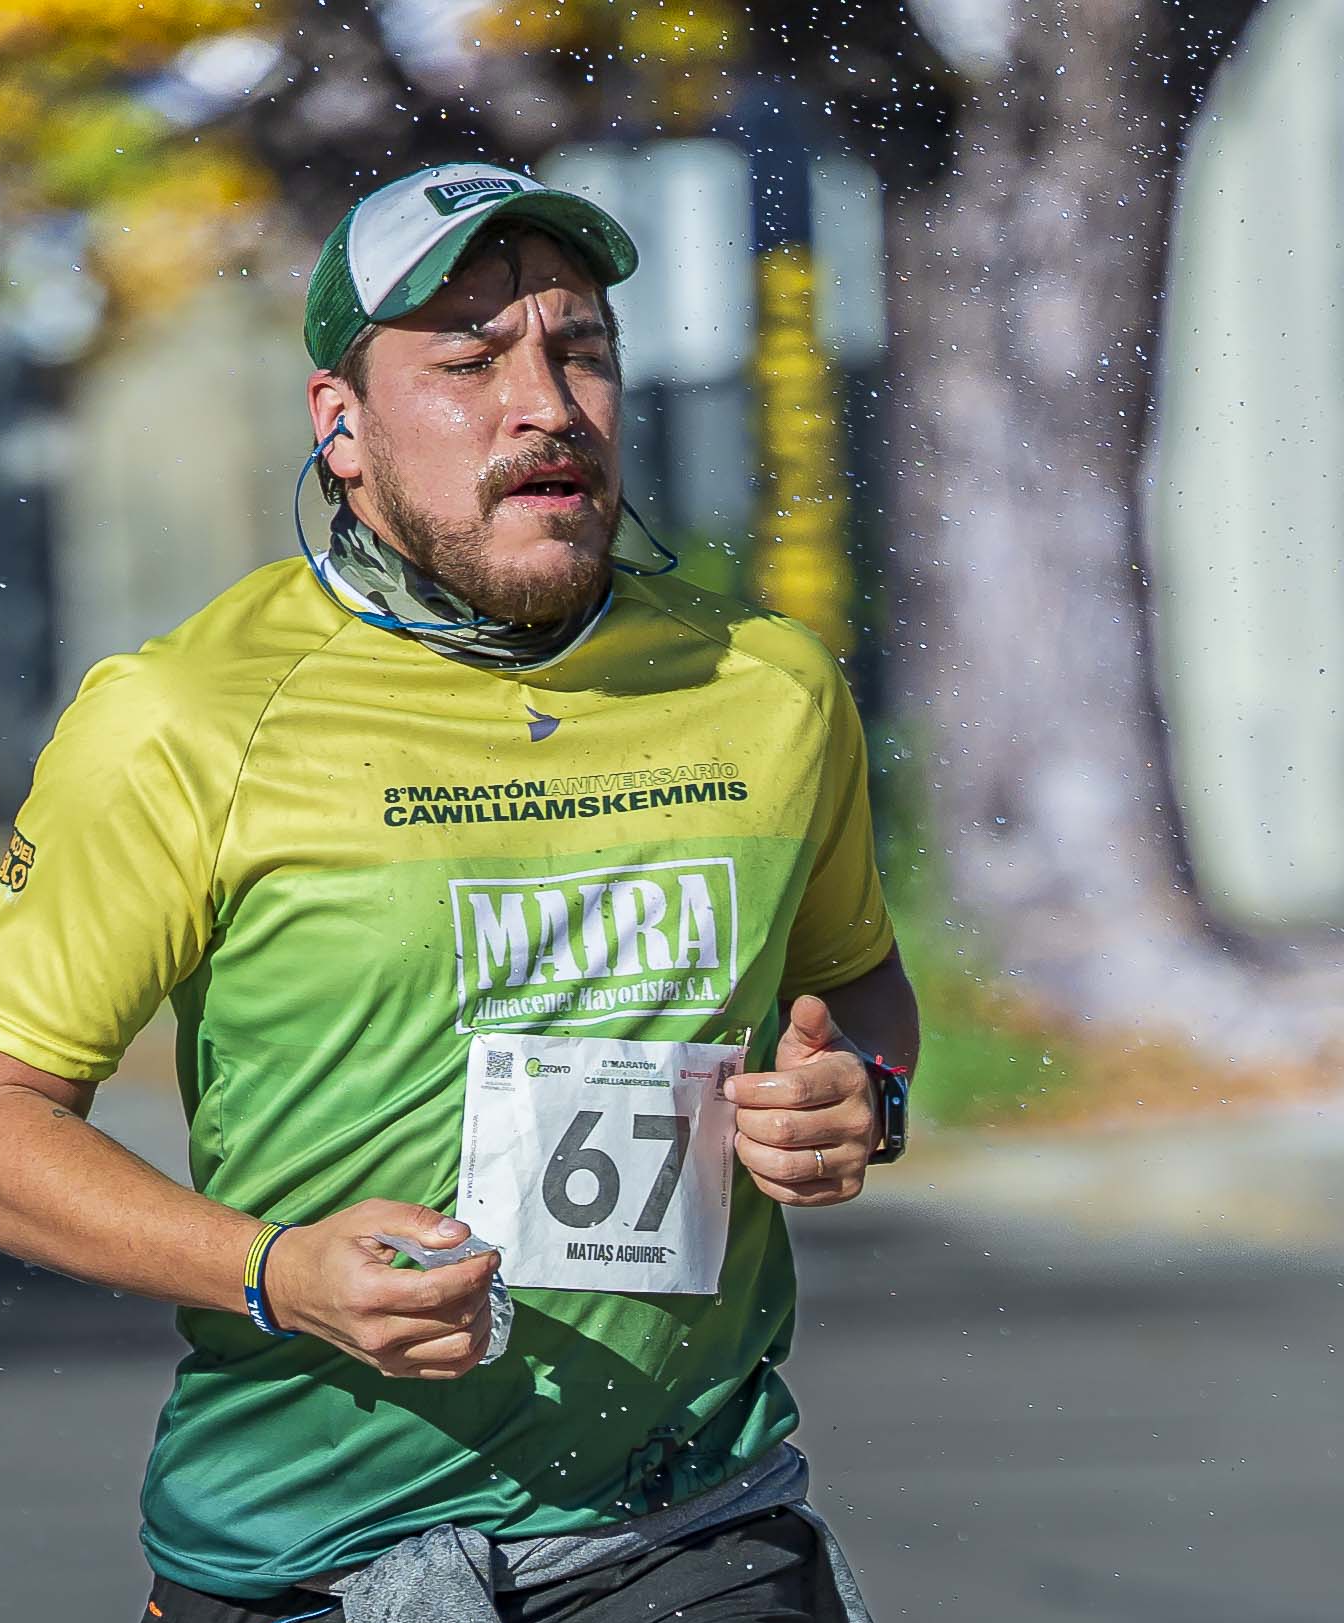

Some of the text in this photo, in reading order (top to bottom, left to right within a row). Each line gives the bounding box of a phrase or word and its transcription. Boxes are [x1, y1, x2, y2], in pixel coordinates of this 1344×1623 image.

[384, 781, 748, 827] CAWILLIAMSKEMMIS
[468, 873, 720, 990] MAIRA
[475, 976, 721, 1020] Almacenes Mayoristas S.A.
[542, 1110, 691, 1233] 67
[566, 1242, 667, 1264] MATIAS AGUIRRE
